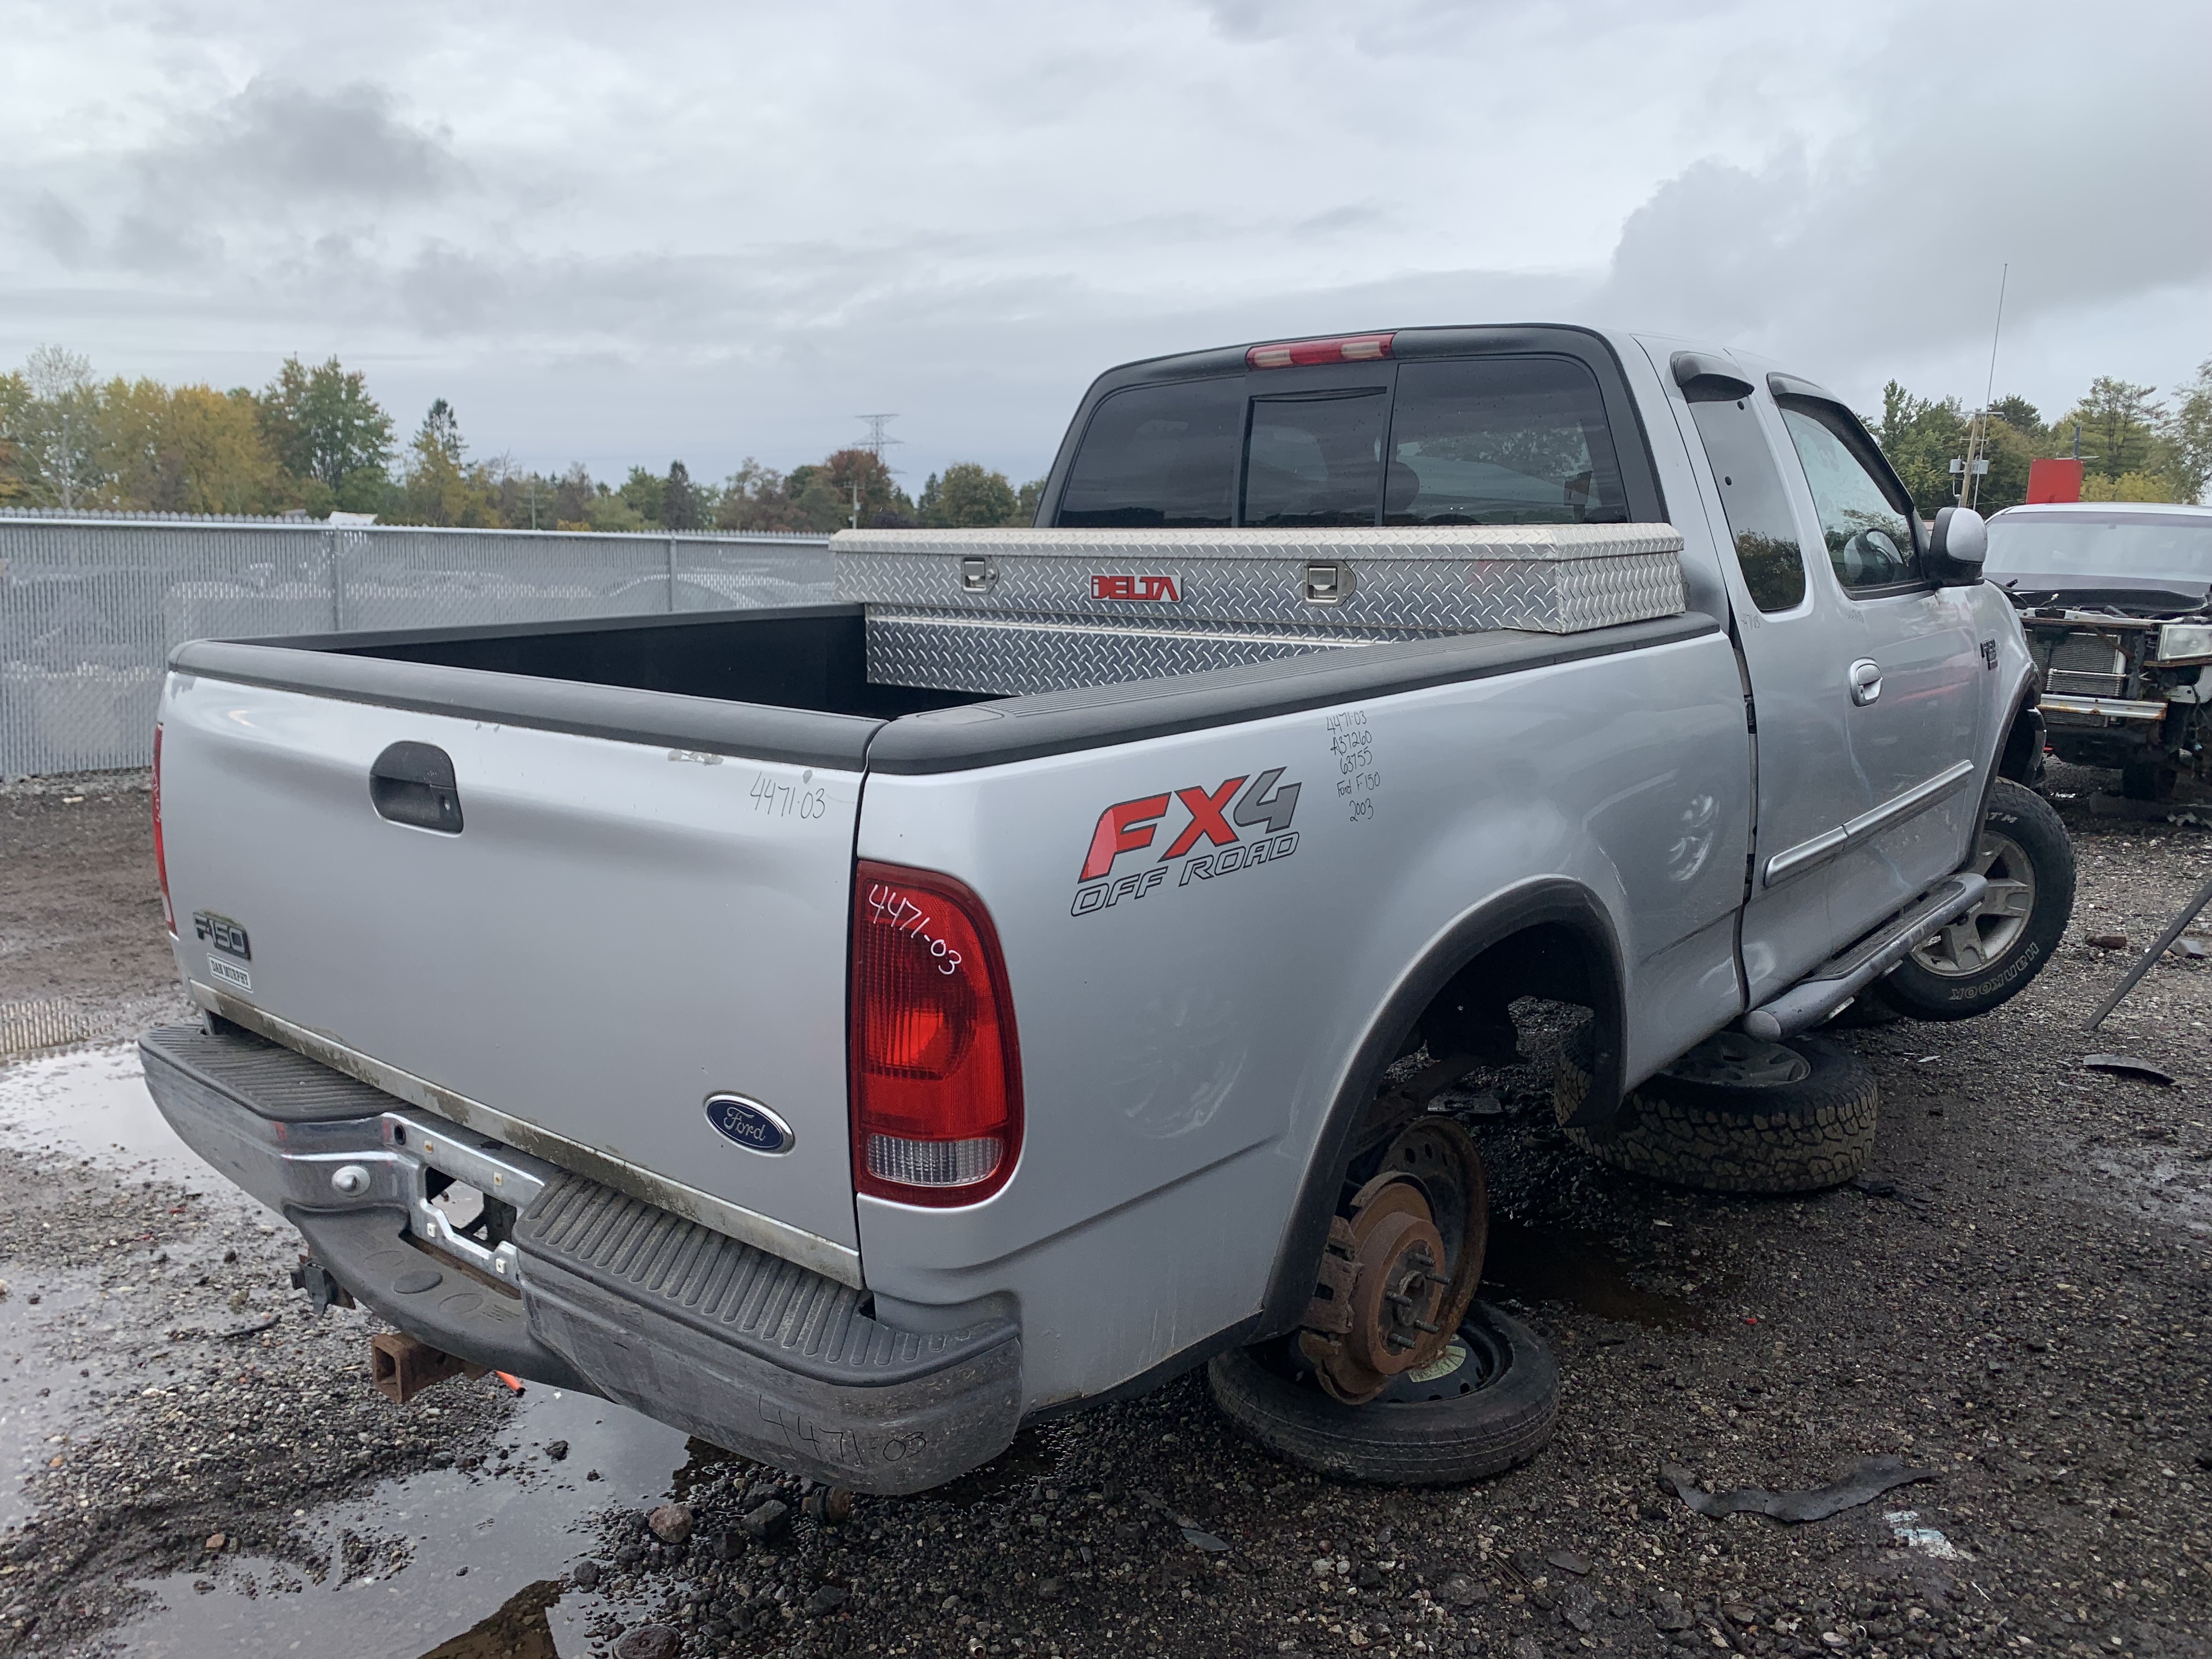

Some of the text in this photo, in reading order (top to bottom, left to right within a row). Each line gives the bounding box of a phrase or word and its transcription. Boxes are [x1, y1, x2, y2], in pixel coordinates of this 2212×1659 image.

[1091, 575, 1180, 601] DELTA
[1330, 730, 1373, 757] A37260
[1340, 746, 1373, 775] 63755
[1336, 779, 1352, 798] Ford
[1077, 766, 1302, 884] FX4
[1348, 797, 1374, 822] 2003
[1070, 831, 1300, 917] OFF ROAD
[868, 883, 962, 975] 4471-03
[723, 1106, 766, 1142] Ford
[759, 1394, 927, 1466] 4471-03
